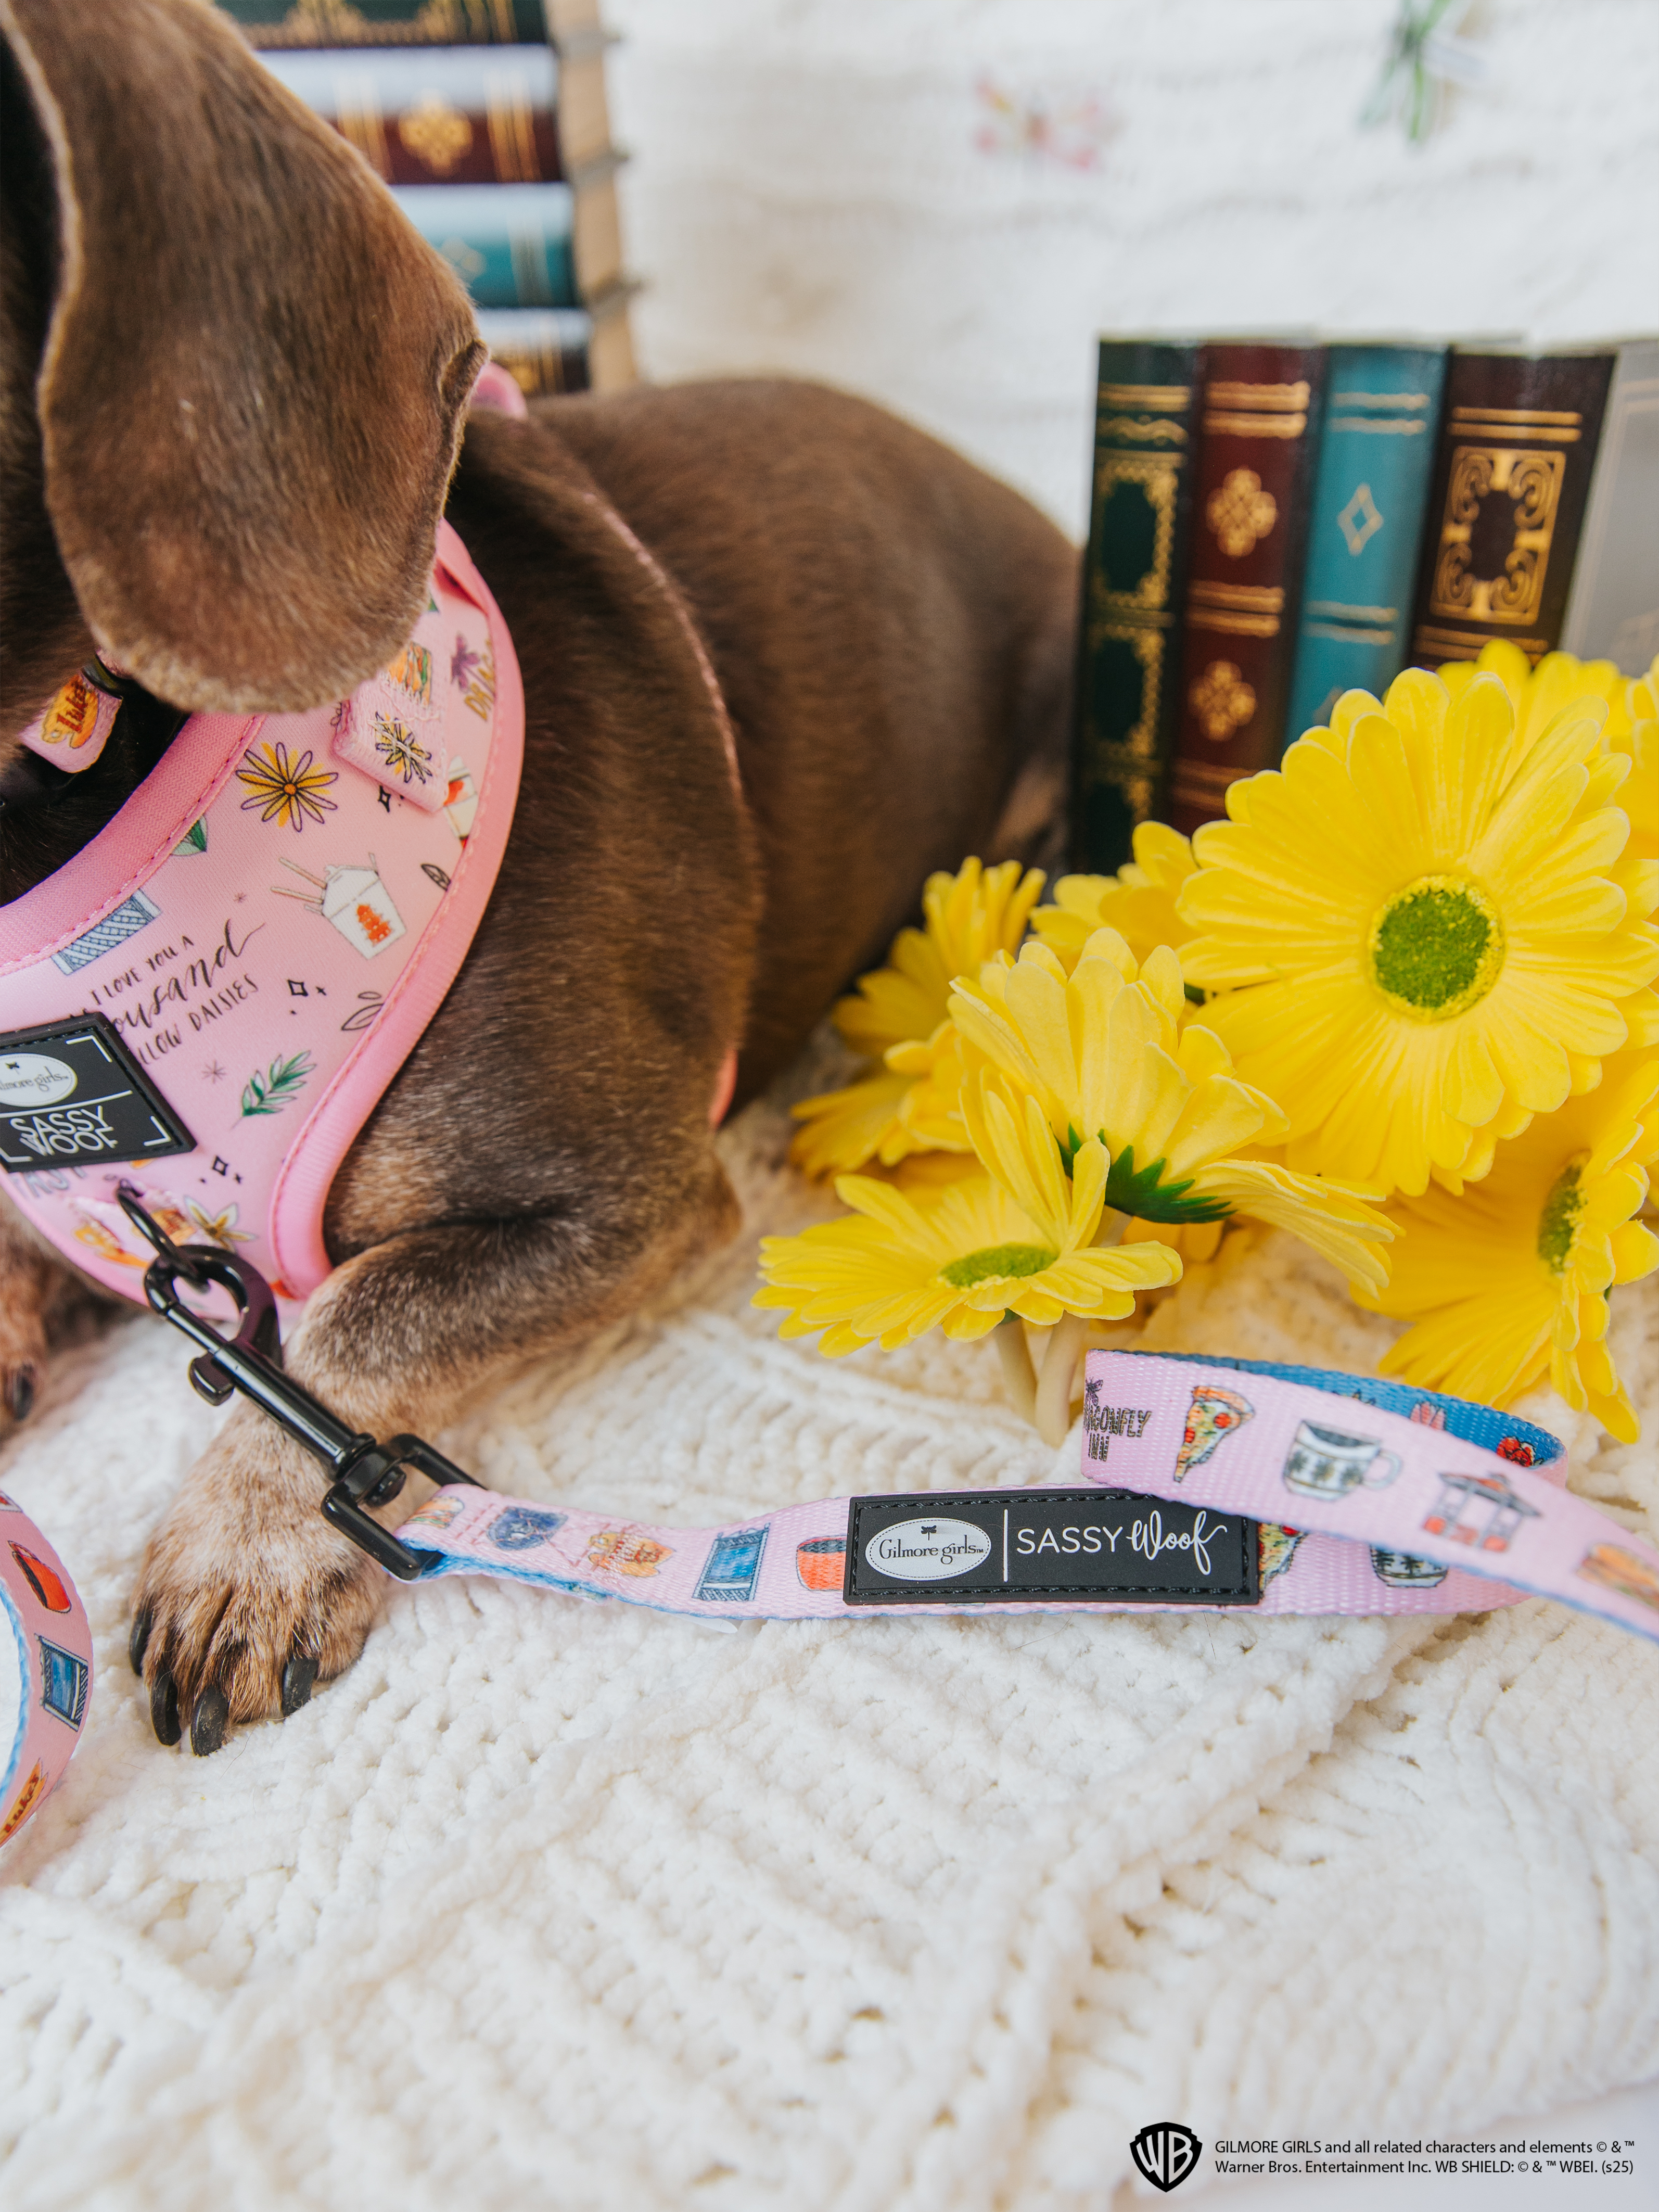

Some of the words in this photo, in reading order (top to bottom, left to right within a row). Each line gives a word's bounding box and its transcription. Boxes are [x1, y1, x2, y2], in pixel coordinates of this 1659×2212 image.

[92, 989, 102, 1005] I
[104, 967, 143, 998] LOVE
[146, 946, 178, 972] YOU
[111, 919, 265, 1034] ousand
[188, 973, 259, 1032] DAISIES
[9, 1104, 109, 1139] SASSY
[19, 1126, 119, 1156] WOOF
[879, 1538, 939, 1559] Gilmore
[1016, 1525, 1124, 1555] SASSY
[1126, 1509, 1228, 1575] Woof
